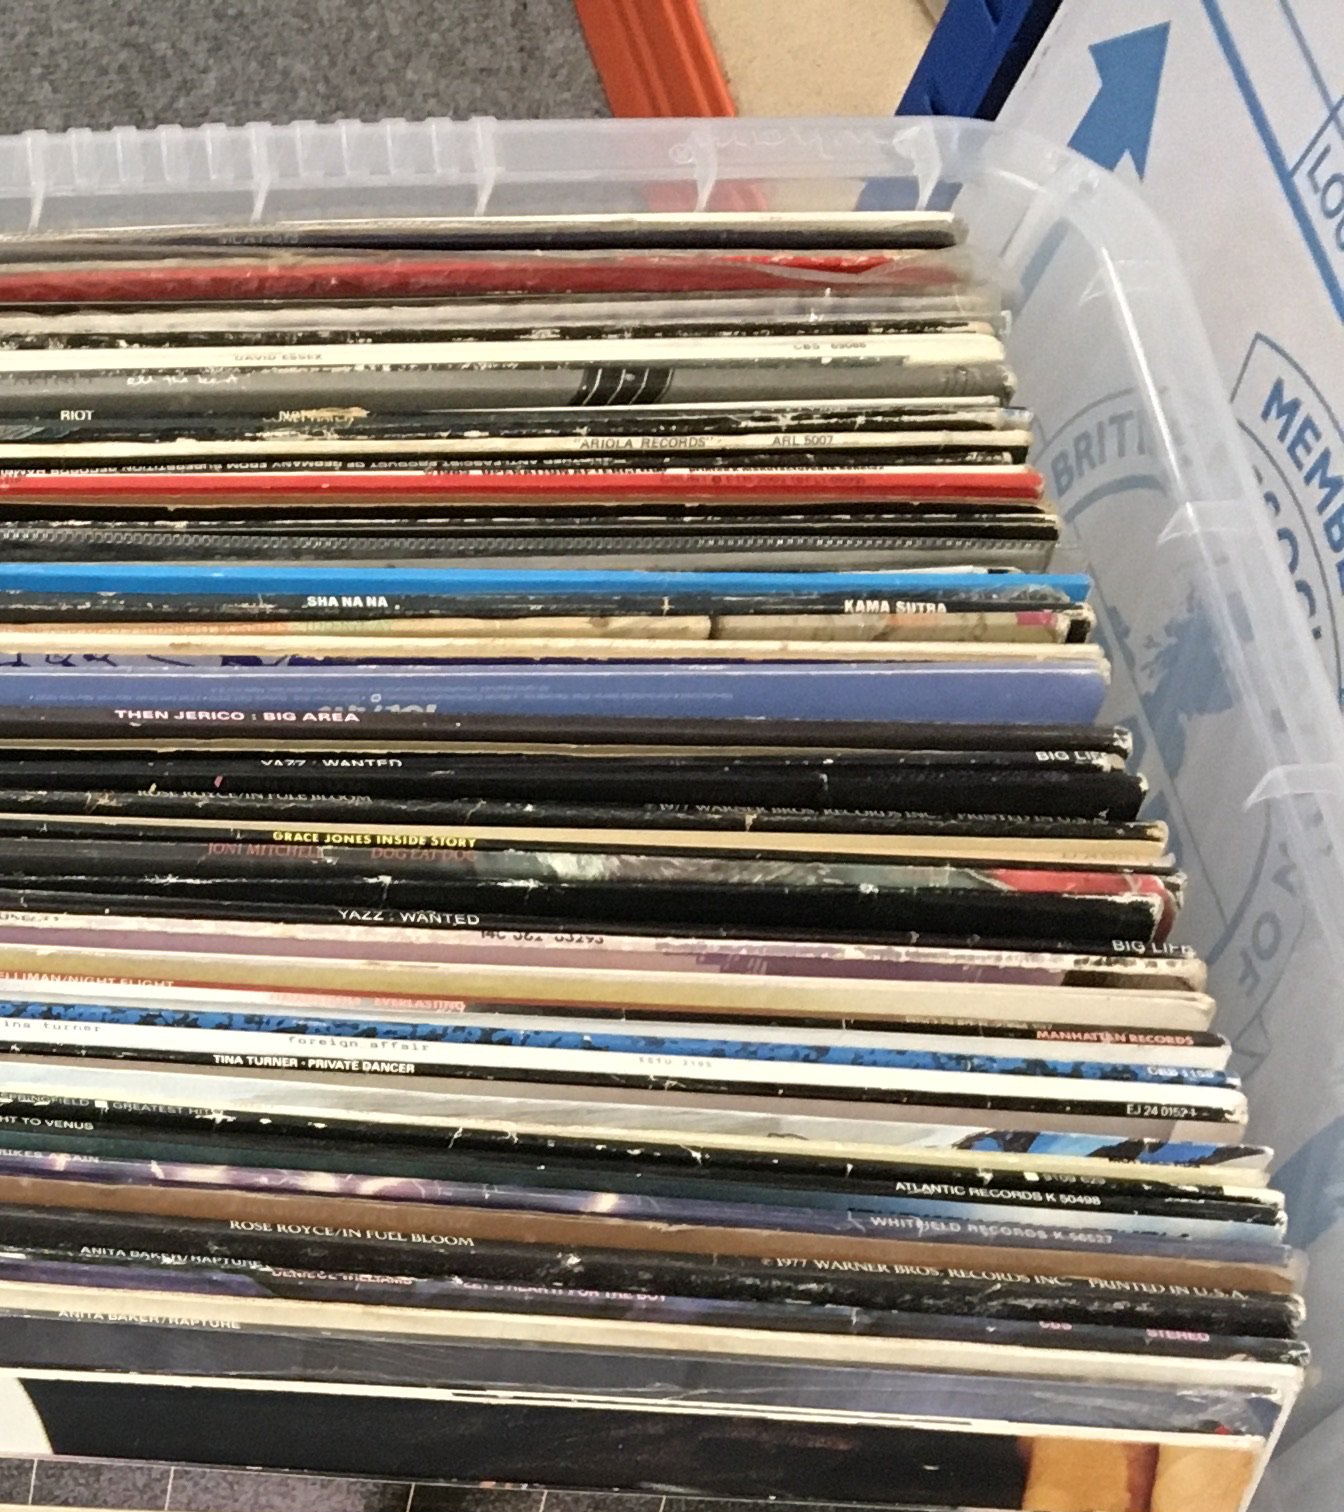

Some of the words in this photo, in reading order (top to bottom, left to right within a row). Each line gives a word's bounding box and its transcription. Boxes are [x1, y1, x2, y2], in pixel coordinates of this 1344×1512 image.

[60, 410, 94, 420] RIOT
[771, 436, 799, 446] ARL
[804, 435, 835, 446] 5007
[307, 596, 338, 607] SHA
[341, 596, 363, 607] NA
[366, 596, 388, 607] NA
[845, 600, 890, 613] KAMA
[895, 601, 947, 613] SUTRA
[115, 710, 169, 721] THEN
[175, 711, 245, 722] JERICO
[263, 711, 296, 722] BIG
[303, 712, 360, 722] AREA
[1036, 750, 1069, 761] BIG
[273, 831, 320, 842] GRACE
[324, 833, 371, 844] JONES
[376, 835, 427, 845] INSIDE
[431, 836, 477, 848] STORY
[207, 844, 243, 857] JONI
[339, 910, 382, 921] YAZZ
[401, 911, 480, 925] WANTED
[1112, 940, 1146, 951] BIG
[44, 1021, 101, 1033] turner
[288, 1035, 358, 1049] foreign
[370, 1039, 430, 1051] affair
[1036, 1030, 1126, 1043] MANHATTAN
[1129, 1033, 1194, 1046] RECORDS
[213, 1054, 243, 1066] TINA
[247, 1056, 298, 1068] TURNER
[308, 1058, 359, 1072] PRIVATE
[362, 1061, 415, 1074] DANCER
[1126, 1104, 1141, 1115] EJ
[1144, 1105, 1159, 1116] 24
[21, 1116, 41, 1126] TO
[44, 1119, 94, 1131] VENUS
[895, 1181, 965, 1197] ATLANTIC
[969, 1185, 1042, 1202] RECORDS
[1046, 1191, 1057, 1203] K
[1059, 1193, 1102, 1206] 50498
[870, 1216, 961, 1235] WHITFIELD
[81, 1245, 127, 1257] ANITA
[230, 1220, 273, 1233] ROSE
[277, 1222, 362, 1239] ROYCE/IN
[412, 1233, 475, 1247] BLOOM
[777, 1257, 808, 1270] 1977
[813, 1259, 892, 1274] WARNER
[948, 1268, 1029, 1284] RECORDS
[1088, 1277, 1163, 1294] PRINTED
[1167, 1284, 1191, 1296] IN
[1146, 1328, 1210, 1342] STEREO
